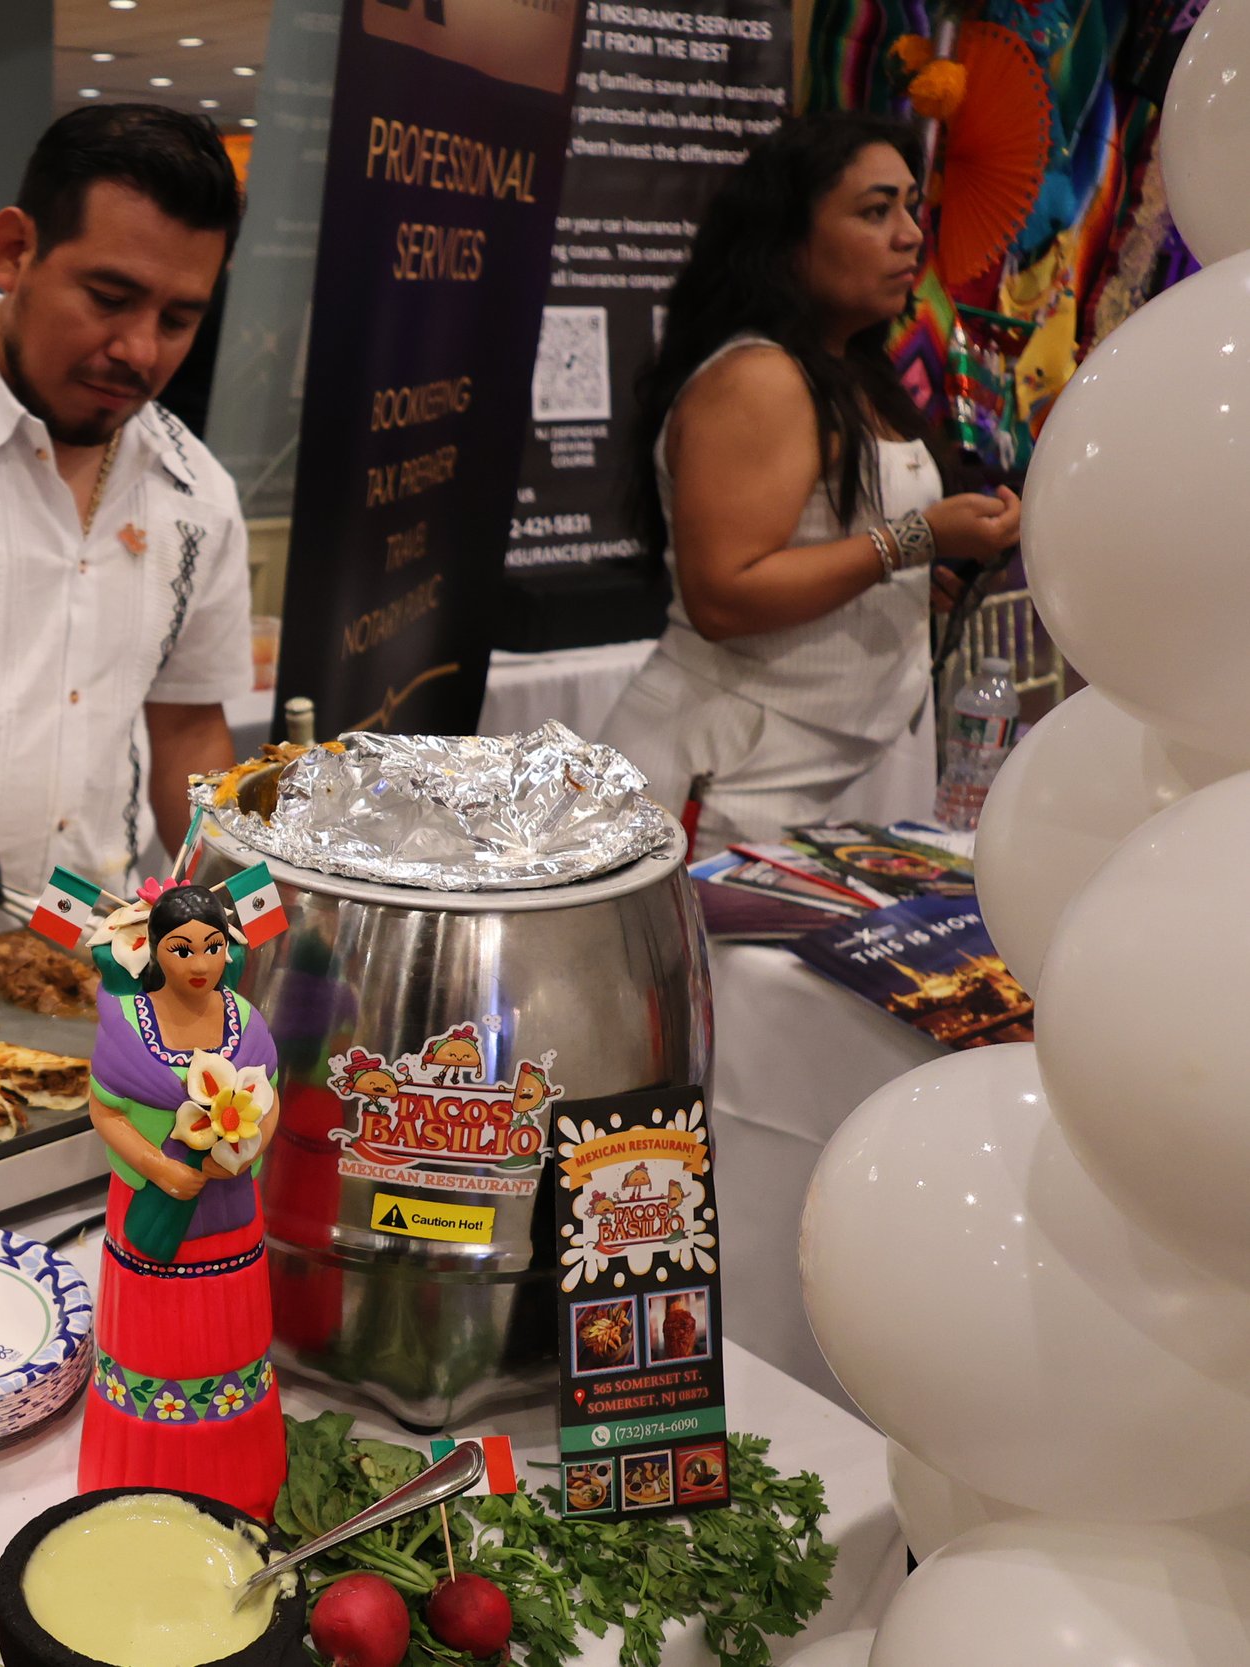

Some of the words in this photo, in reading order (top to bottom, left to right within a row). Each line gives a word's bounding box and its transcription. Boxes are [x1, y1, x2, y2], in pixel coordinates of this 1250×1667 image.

[600, 3, 693, 33] INSURANCE
[695, 14, 773, 41] SERVICES
[604, 31, 654, 55] FROM
[655, 36, 688, 59] THE
[689, 41, 730, 63] BEST
[599, 70, 654, 92] families
[654, 80, 686, 96] save
[687, 79, 724, 99] while
[578, 106, 646, 126] protected
[647, 109, 678, 128] with
[678, 111, 712, 131] what
[713, 114, 743, 137] they
[366, 116, 537, 204] PROFESSIONAL
[572, 136, 609, 156] them
[610, 138, 652, 160] invest
[652, 142, 677, 161] the
[572, 218, 601, 235] your
[602, 219, 624, 234] car
[623, 216, 683, 235] insurance
[393, 222, 487, 281] SERVICES
[568, 269, 629, 288] insurance
[366, 465, 398, 507] TAX
[850, 940, 905, 964] THIS
[905, 930, 931, 946] IS
[930, 913, 981, 937] HOW
[391, 1093, 514, 1127] TACOS
[362, 1111, 542, 1157] BASILIO
[575, 1142, 626, 1168] MEXICAN
[629, 1138, 697, 1155] RESTAURANT
[341, 1160, 420, 1184] MEXICAN
[423, 1172, 536, 1194] RESTAURANT
[411, 1213, 456, 1229] Caution
[458, 1218, 483, 1231] Hot!
[614, 1202, 670, 1223] TACOS
[599, 1215, 685, 1243] BASILIO
[593, 1383, 612, 1395] 565
[615, 1372, 681, 1392] SOMERSET
[684, 1369, 702, 1382] ST.
[587, 1394, 659, 1415] SOMERSET,
[662, 1392, 677, 1406] NJ
[678, 1387, 709, 1401] 08873
[614, 1417, 699, 1443] (732)874-6090
